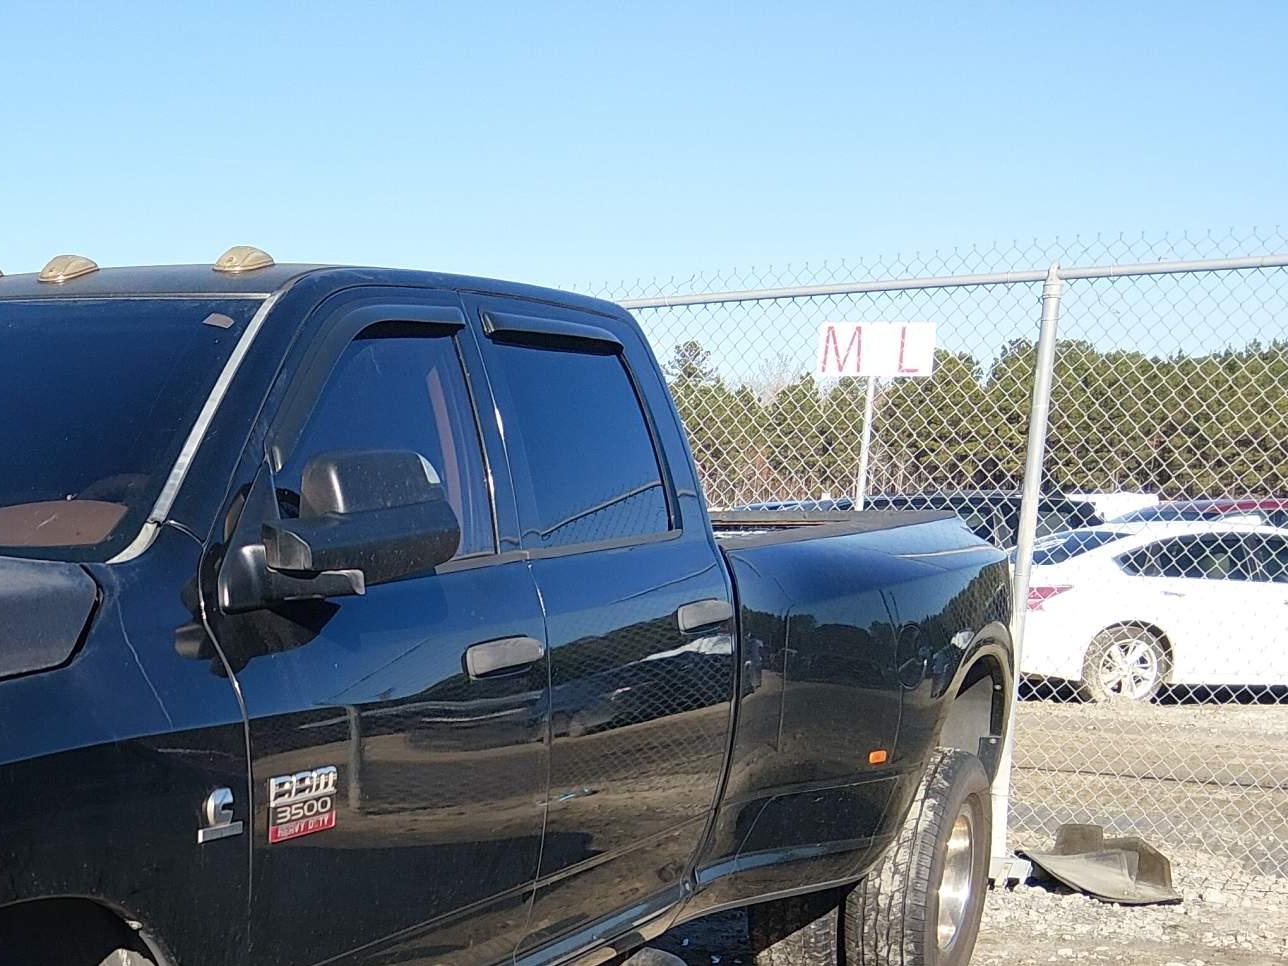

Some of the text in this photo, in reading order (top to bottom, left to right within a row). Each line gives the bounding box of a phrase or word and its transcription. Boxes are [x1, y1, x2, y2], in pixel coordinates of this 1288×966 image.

[821, 325, 919, 373] M L
[276, 796, 332, 824] 3500
